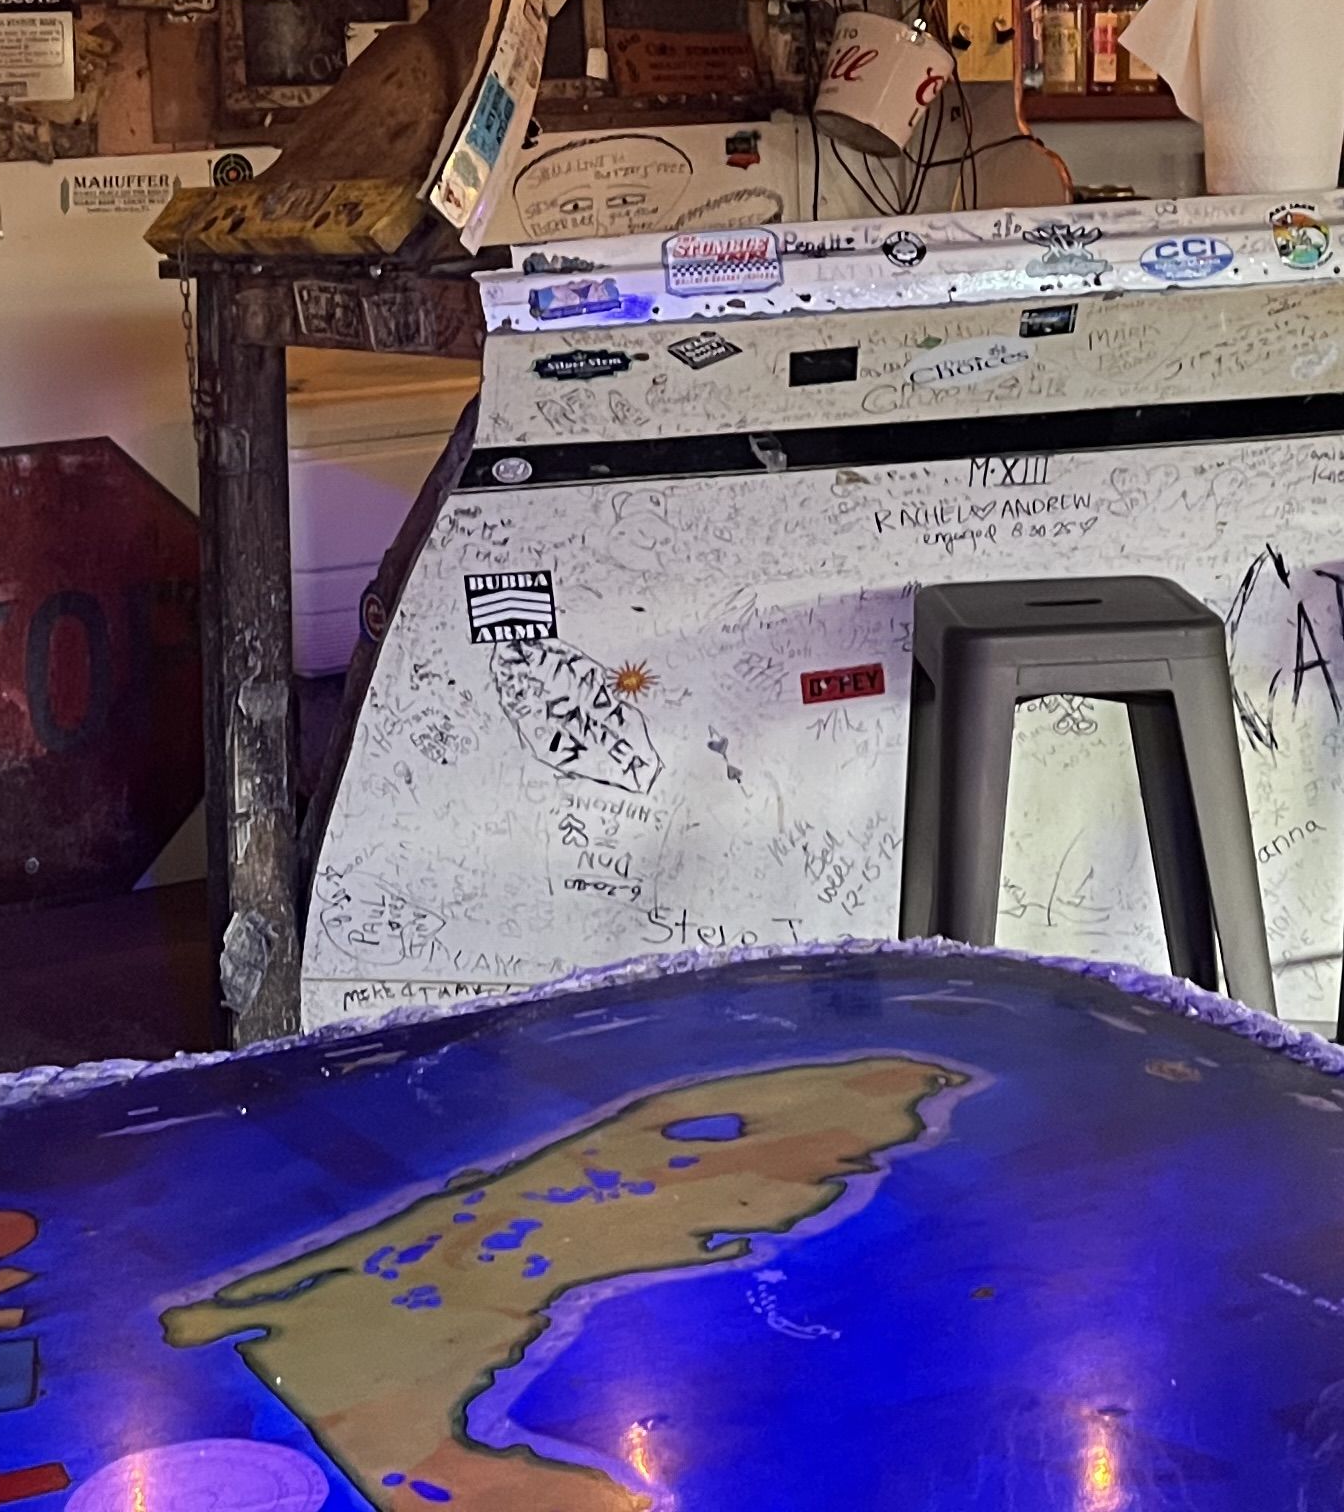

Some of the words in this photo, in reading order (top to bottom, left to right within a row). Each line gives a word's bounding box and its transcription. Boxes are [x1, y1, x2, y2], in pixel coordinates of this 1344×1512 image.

[73, 174, 170, 190] MAHUFFER
[1155, 240, 1218, 261] CCI
[1000, 492, 1093, 520] ANDREW
[468, 571, 549, 592] BUBBA
[474, 622, 552, 644] ARMY
